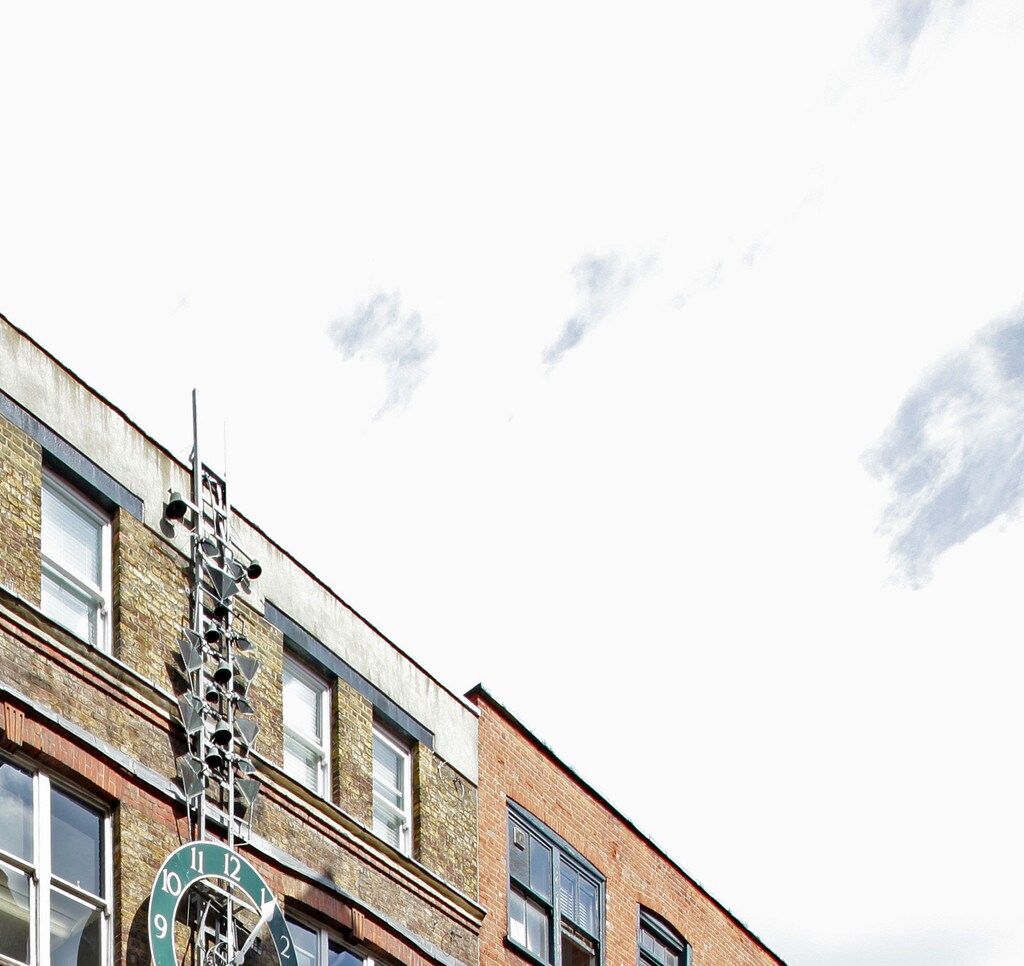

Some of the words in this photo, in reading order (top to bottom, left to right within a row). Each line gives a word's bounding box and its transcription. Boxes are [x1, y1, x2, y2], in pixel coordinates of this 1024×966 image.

[191, 847, 204, 874] 11
[224, 852, 242, 882] 12
[161, 868, 182, 896] 10
[154, 914, 168, 939] 9
[280, 935, 291, 959] 2
